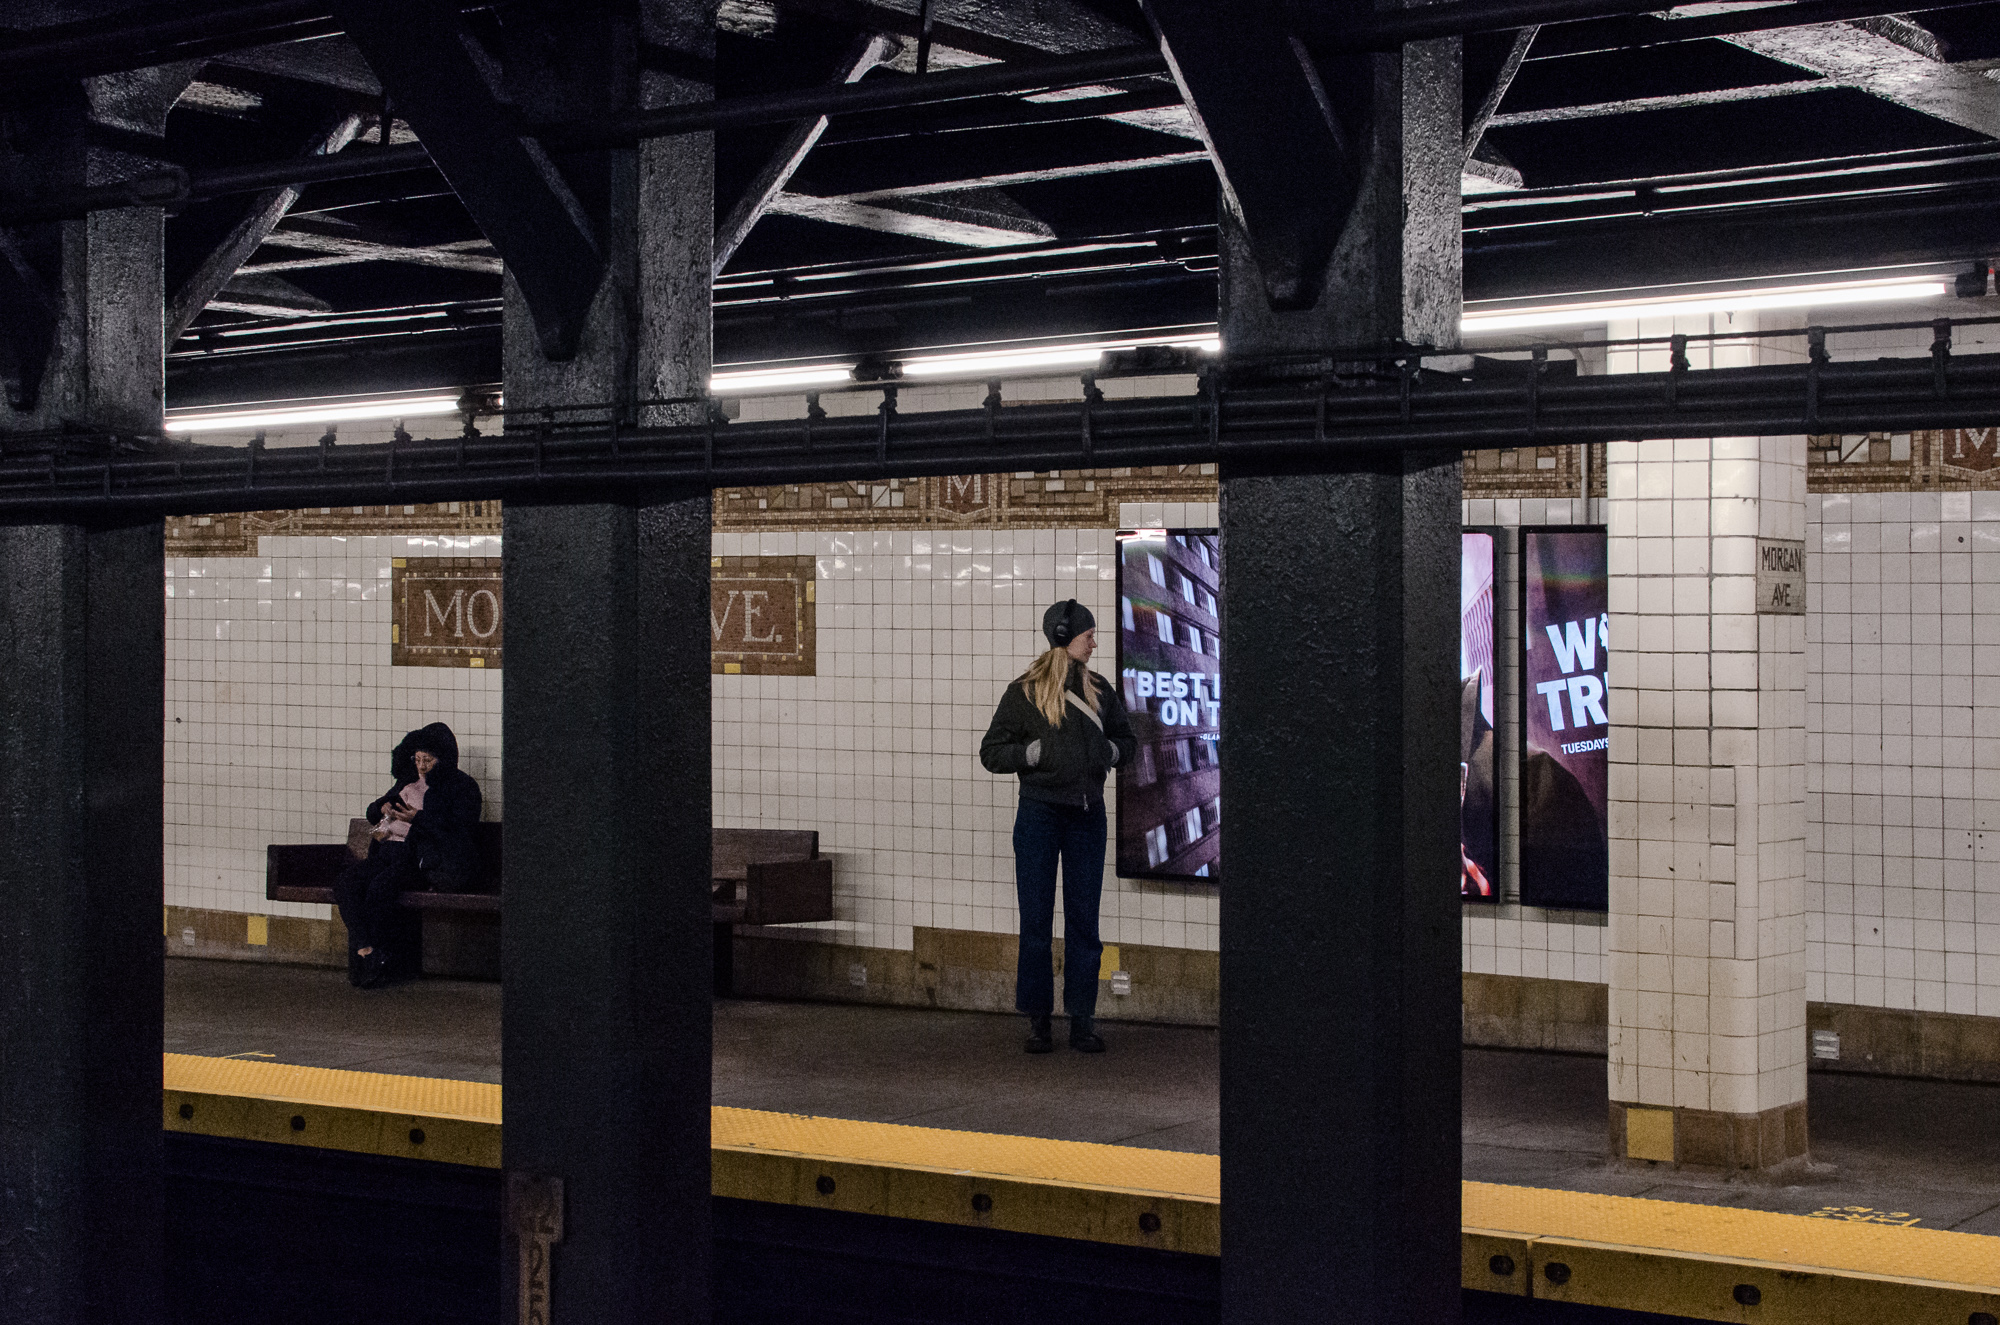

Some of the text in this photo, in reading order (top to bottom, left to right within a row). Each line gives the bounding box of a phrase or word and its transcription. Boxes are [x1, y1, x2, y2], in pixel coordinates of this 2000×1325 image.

[1761, 546, 1802, 572] MORGAN
[1771, 583, 1791, 607] AVE
[423, 589, 783, 643] MO VE.
[1161, 700, 1198, 727] ON
[1536, 672, 1608, 732] TR
